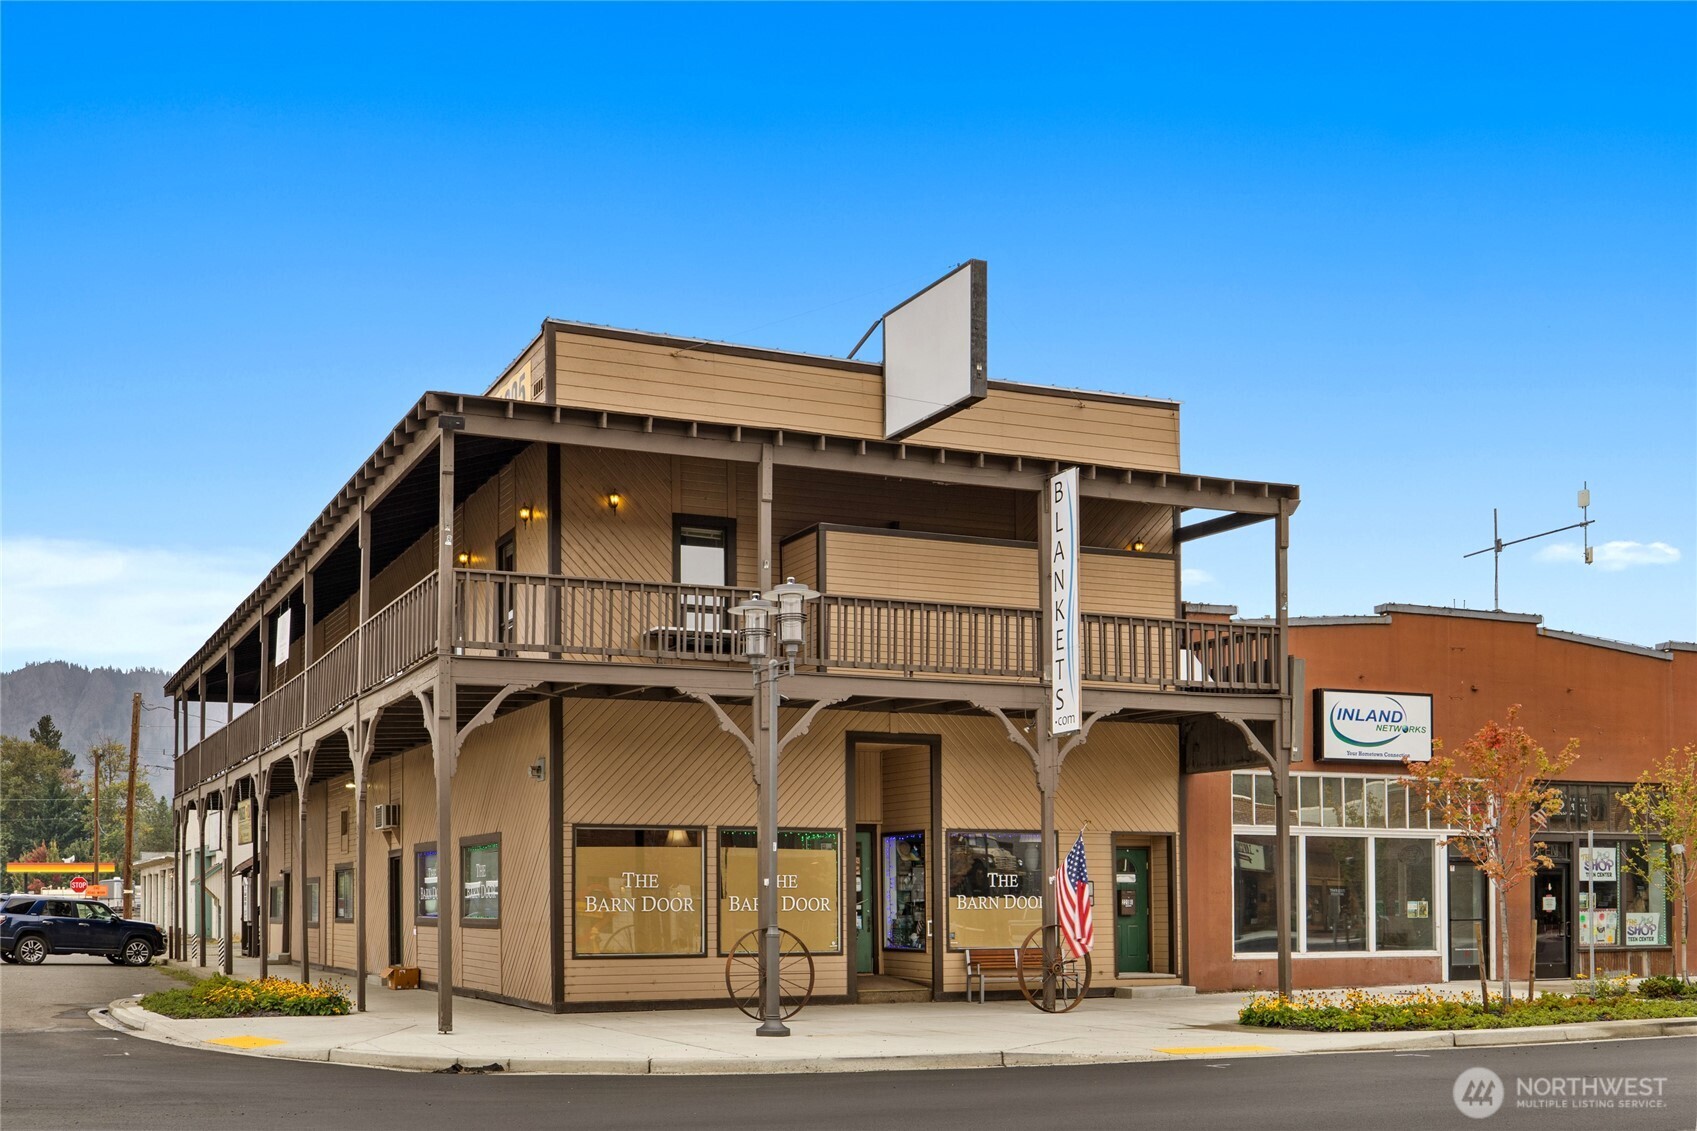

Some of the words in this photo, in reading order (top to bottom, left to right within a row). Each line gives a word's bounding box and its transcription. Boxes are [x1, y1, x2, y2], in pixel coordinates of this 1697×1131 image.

[1054, 481, 1065, 710] BLANKETS
[1337, 708, 1403, 723] INLAND
[1375, 724, 1427, 734] NETWORKS
[621, 872, 659, 889] THE
[776, 874, 798, 889] HE
[987, 872, 1019, 888] THE
[585, 896, 637, 912] BARN
[641, 896, 695, 912] DOOR
[781, 895, 831, 912] DOOR
[956, 894, 999, 910] BARN
[1627, 924, 1657, 936] SHOP
